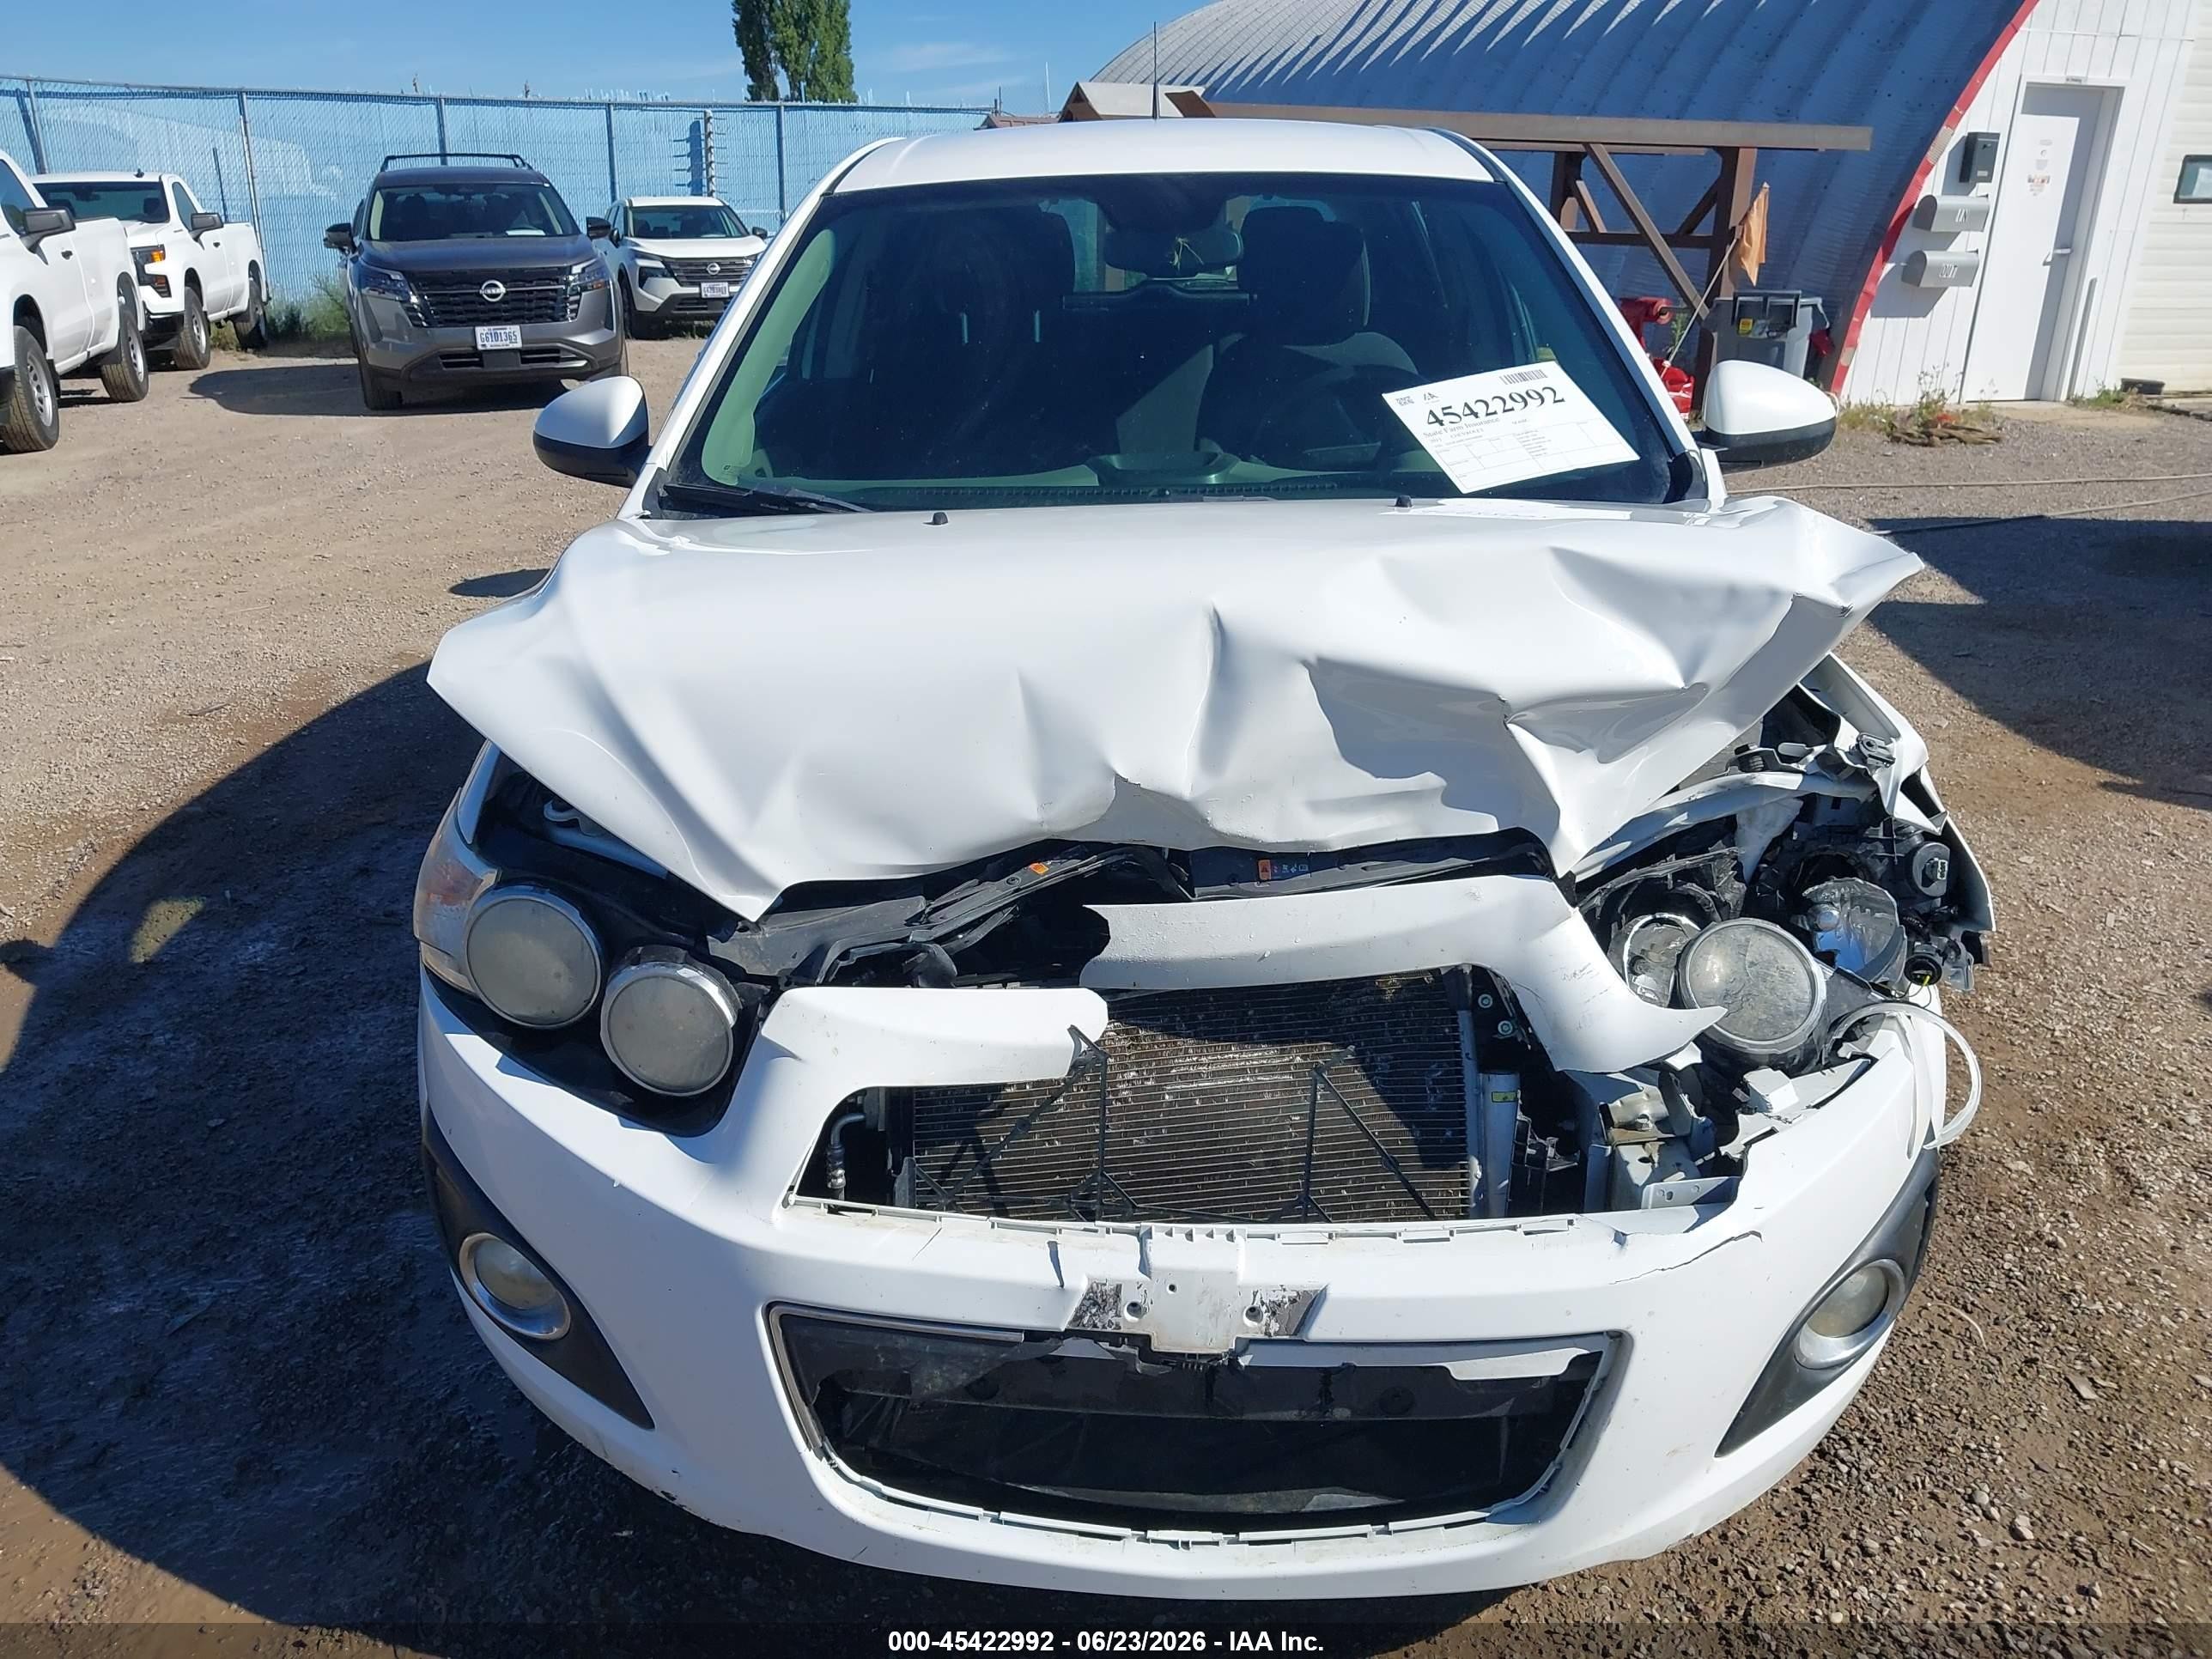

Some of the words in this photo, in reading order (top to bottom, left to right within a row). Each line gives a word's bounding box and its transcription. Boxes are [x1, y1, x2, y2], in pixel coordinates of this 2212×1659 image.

[1427, 386, 1565, 427] 45422992
[1423, 428, 1443, 438] State
[1443, 425, 1464, 434] Farm
[1464, 417, 1501, 428] Insurance
